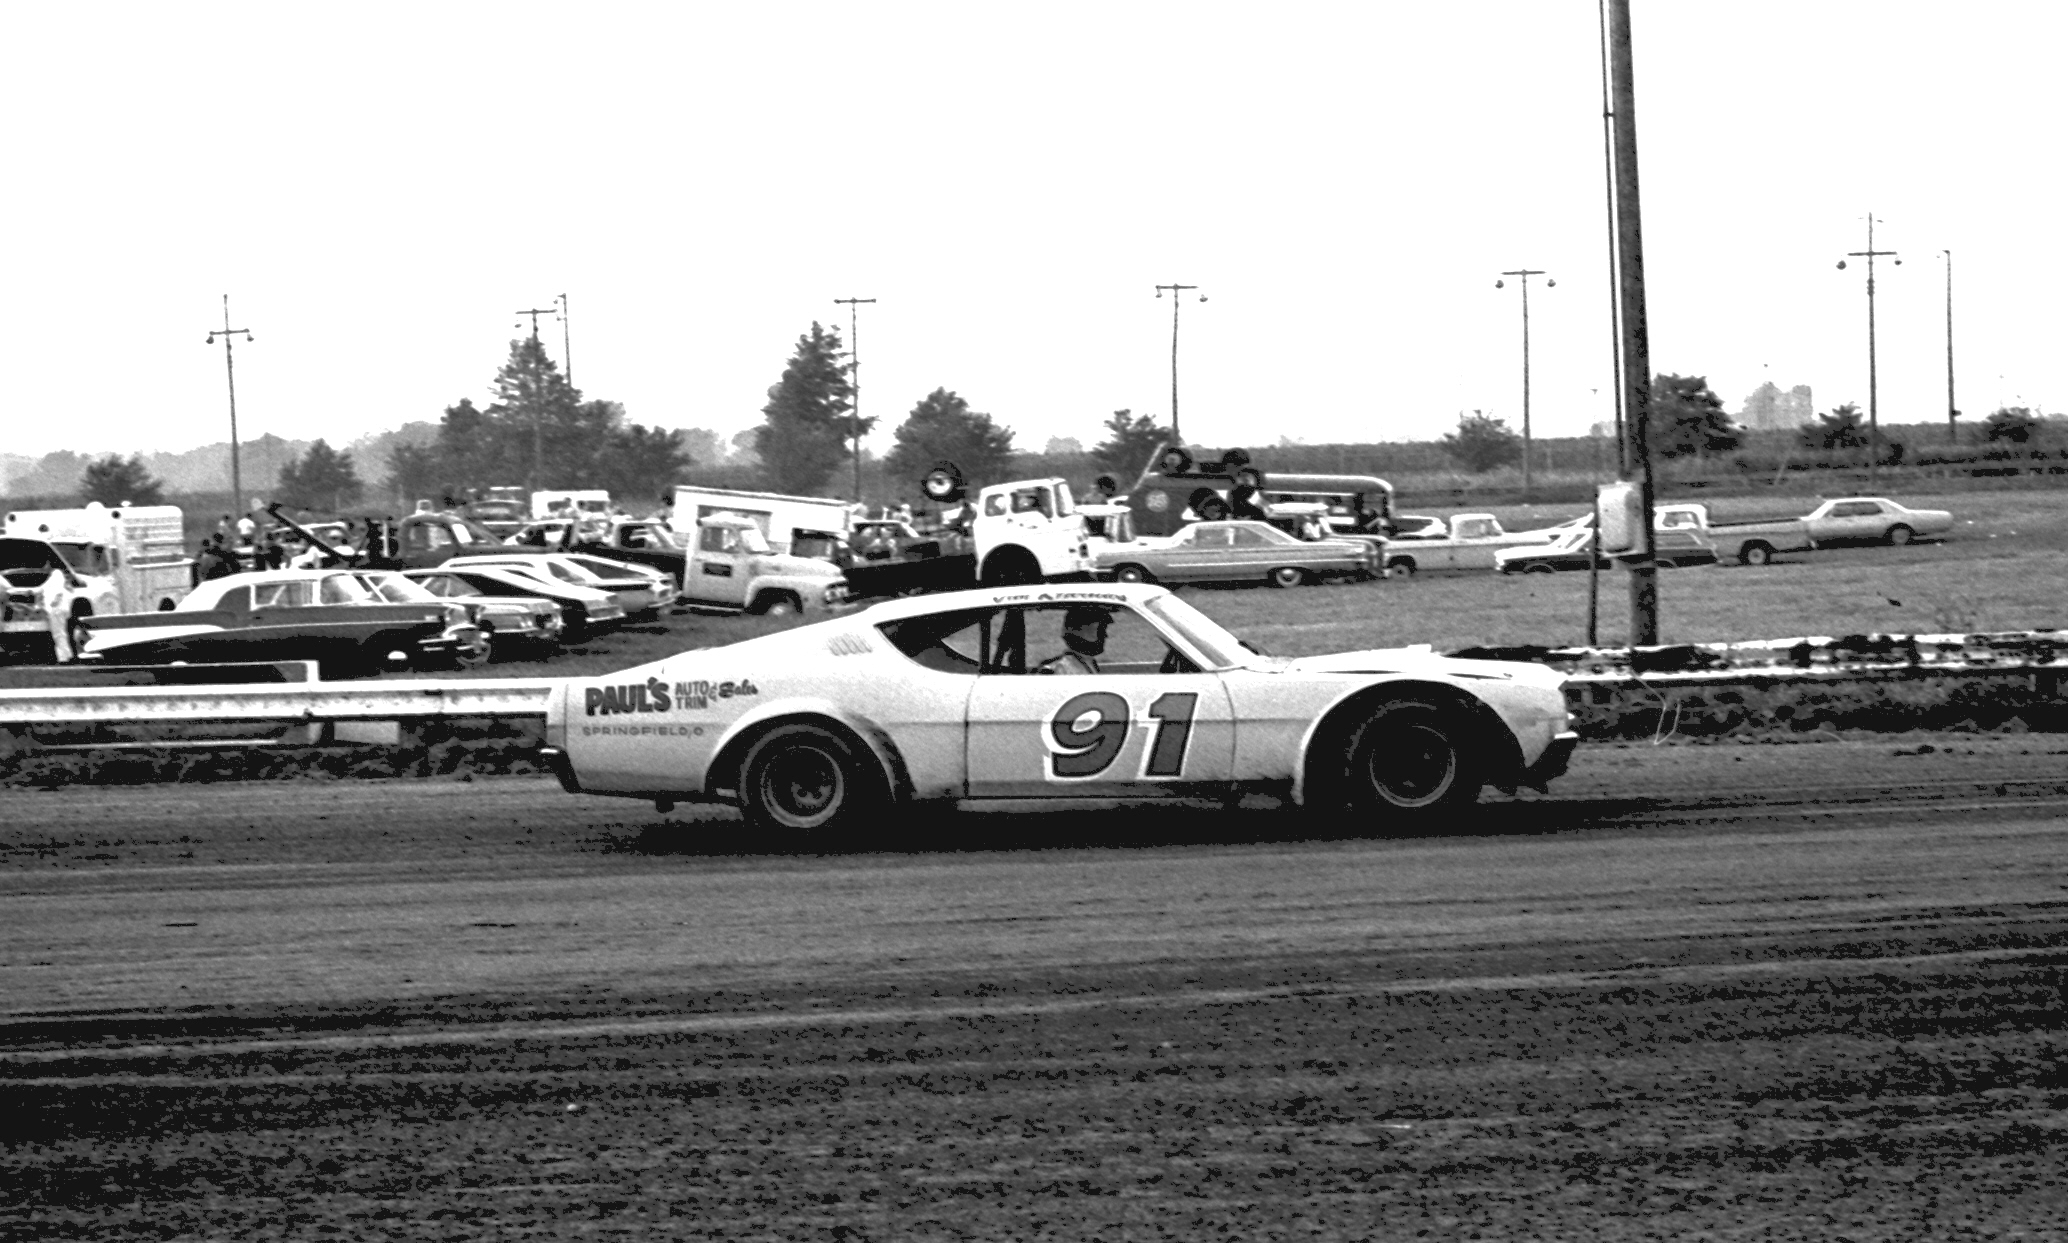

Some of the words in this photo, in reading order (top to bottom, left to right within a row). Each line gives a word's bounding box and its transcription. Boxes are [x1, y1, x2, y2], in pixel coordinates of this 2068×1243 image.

[585, 676, 671, 716] PAUL'S
[675, 680, 709, 696] AUTO
[676, 696, 708, 710] TRIM
[1045, 690, 1199, 779] 91
